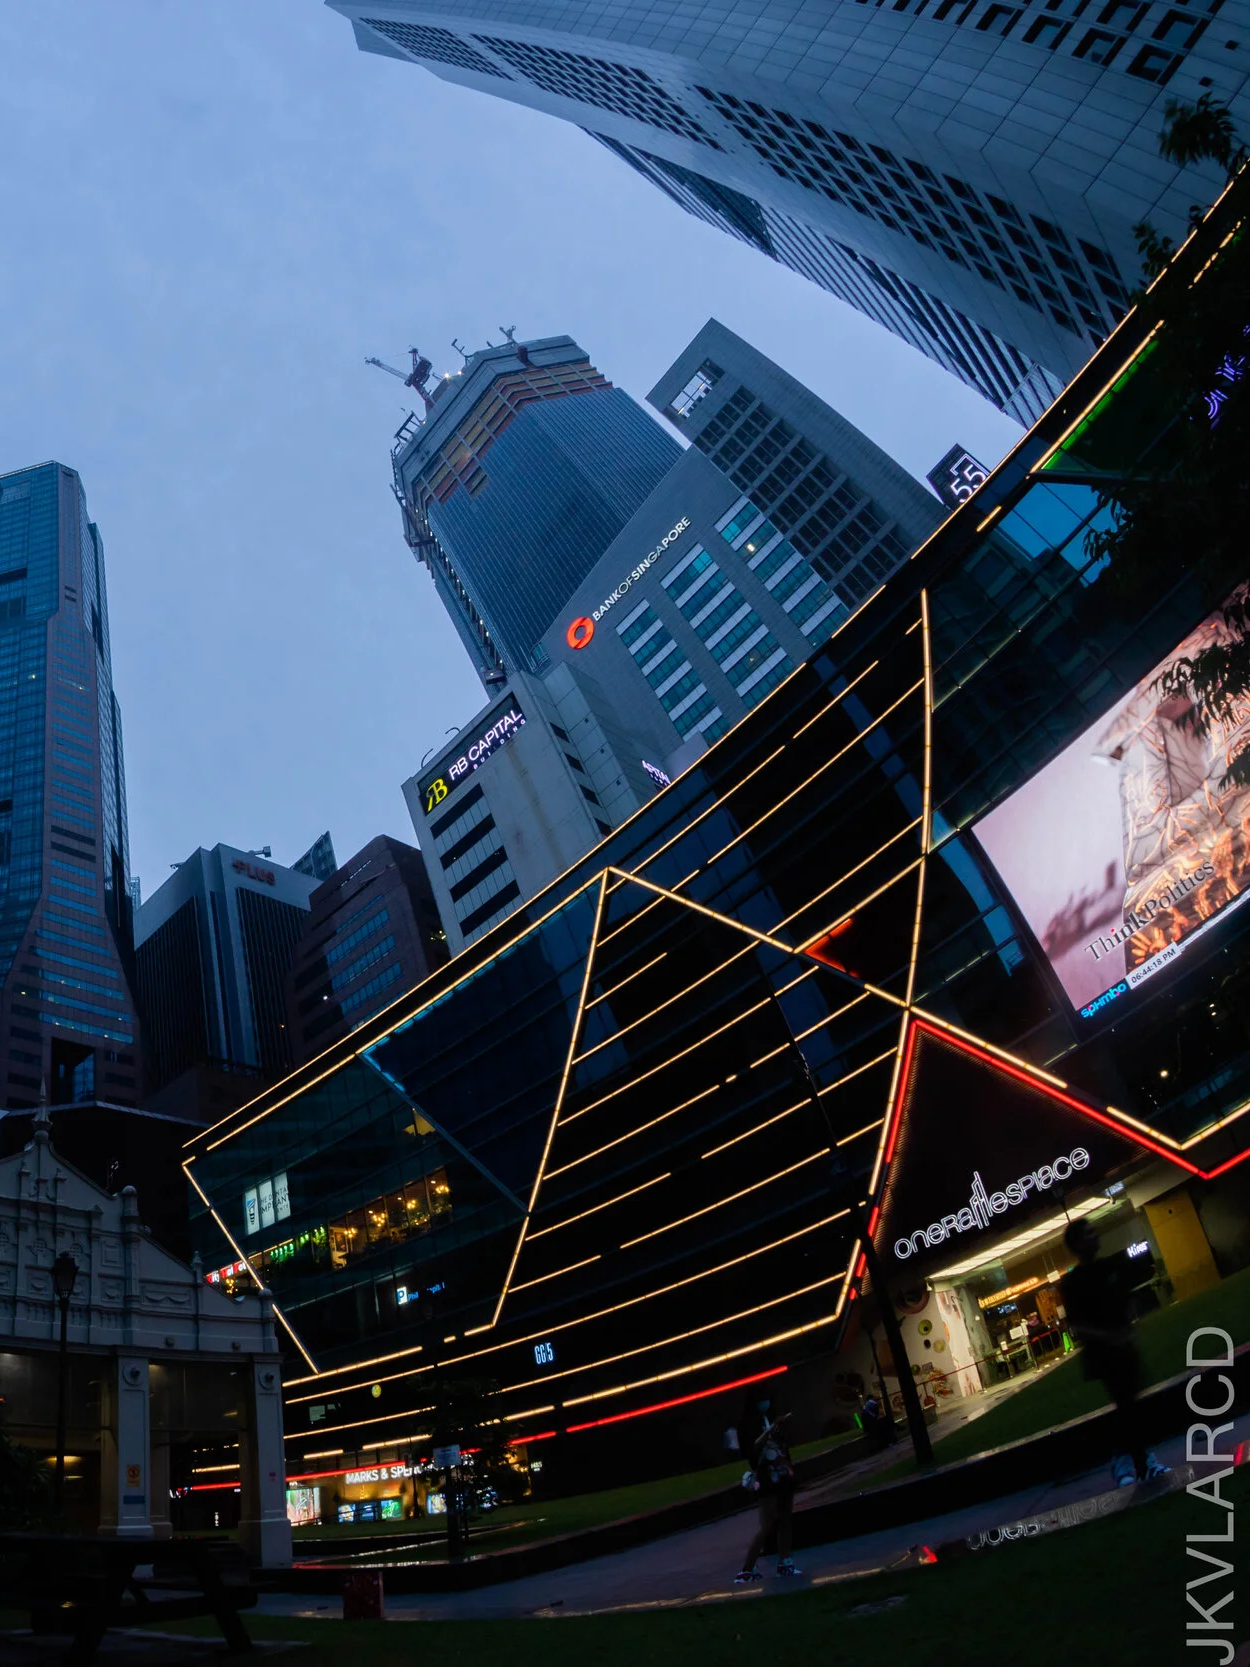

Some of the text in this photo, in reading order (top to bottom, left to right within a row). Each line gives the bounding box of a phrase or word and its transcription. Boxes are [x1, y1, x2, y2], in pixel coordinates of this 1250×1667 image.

[951, 464, 987, 503] 55
[448, 757, 468, 781] RB
[468, 709, 523, 761] CAPITAL
[1084, 860, 1215, 962] ThinkPolitics
[1131, 948, 1177, 984] 06:44:18 PM
[345, 1467, 379, 1485] MARKS
[380, 1467, 389, 1479] &
